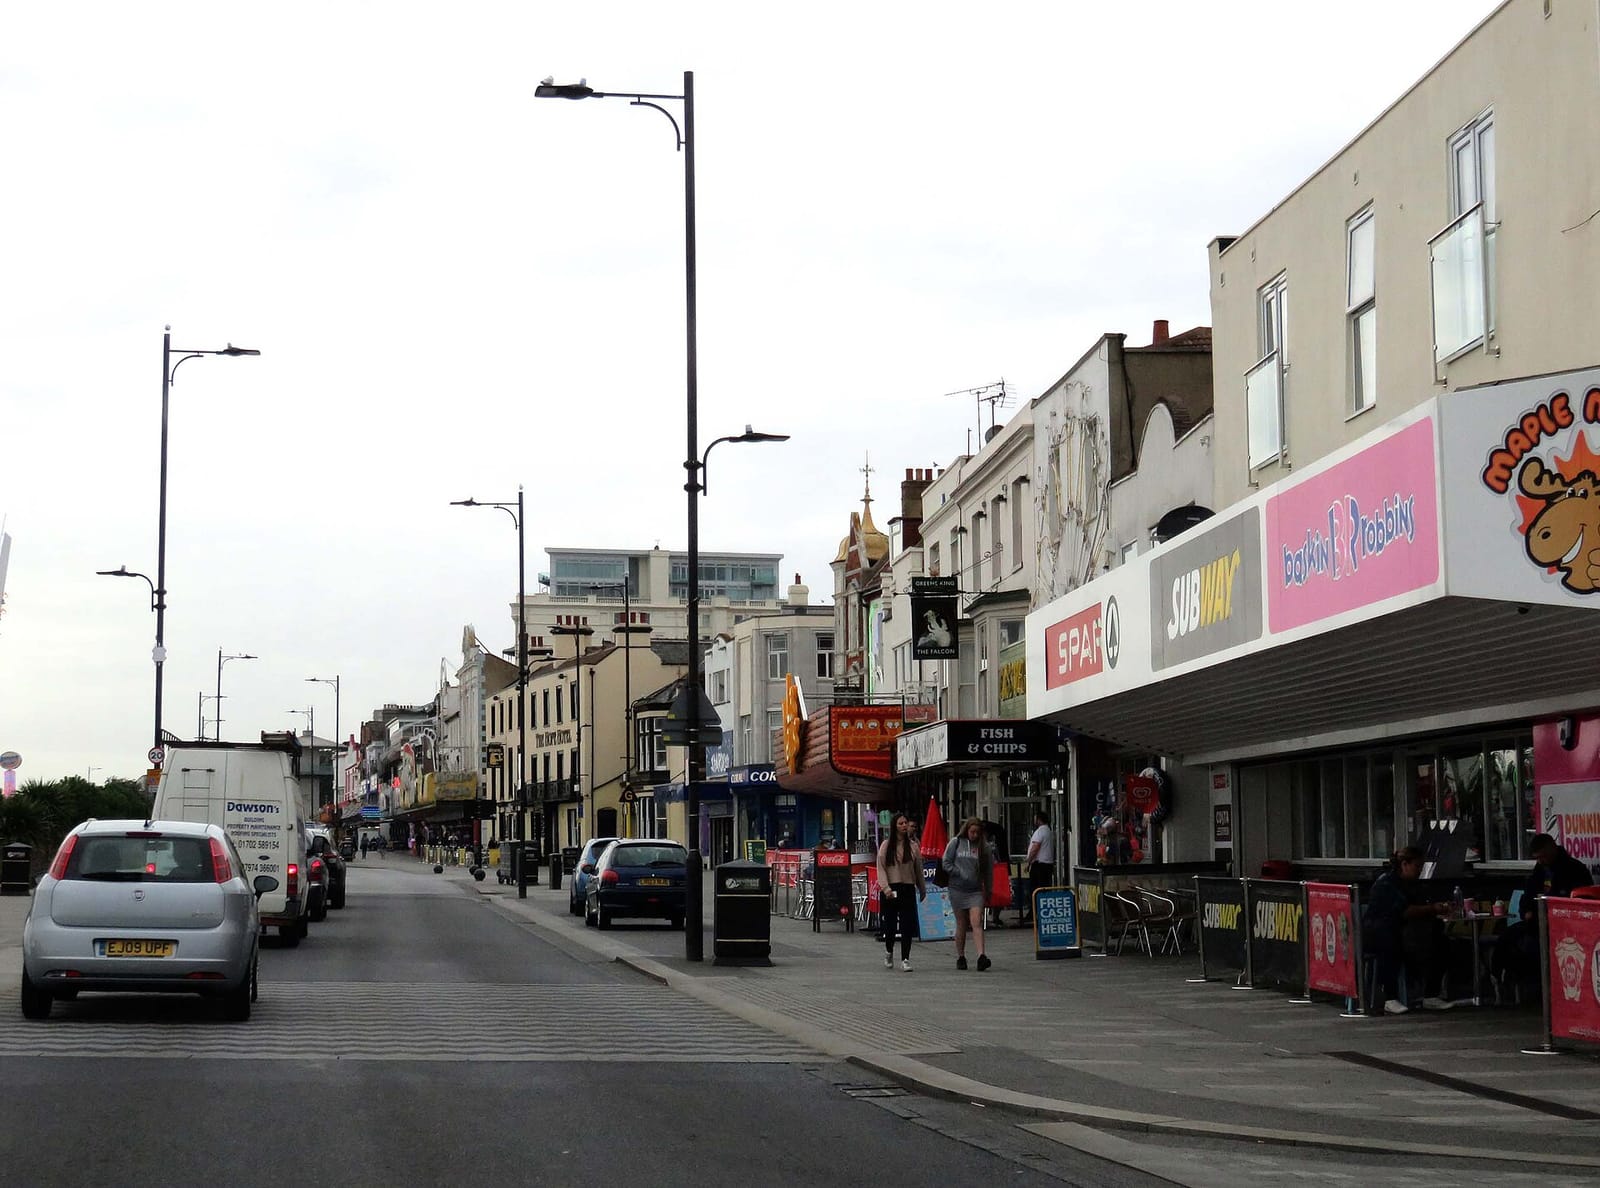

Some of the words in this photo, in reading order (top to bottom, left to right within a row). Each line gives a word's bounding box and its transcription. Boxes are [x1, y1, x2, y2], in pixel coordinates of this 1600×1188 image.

[1483, 392, 1574, 494] MAPLE
[1283, 528, 1330, 588] baskin
[1360, 492, 1415, 559] robbins
[1168, 548, 1240, 640] SUBWAY
[981, 728, 1014, 739] FISH
[967, 744, 980, 754] &
[983, 743, 1028, 754] CHIPS
[227, 801, 280, 813] Dawson's
[1040, 897, 1071, 909] FREE
[1040, 908, 1072, 918] CASH
[1202, 902, 1242, 930] SUBWAY
[1253, 900, 1303, 944] SUBWAY
[1041, 924, 1073, 935] HERE
[108, 942, 142, 954] EJ09
[145, 942, 169, 954] UPF
